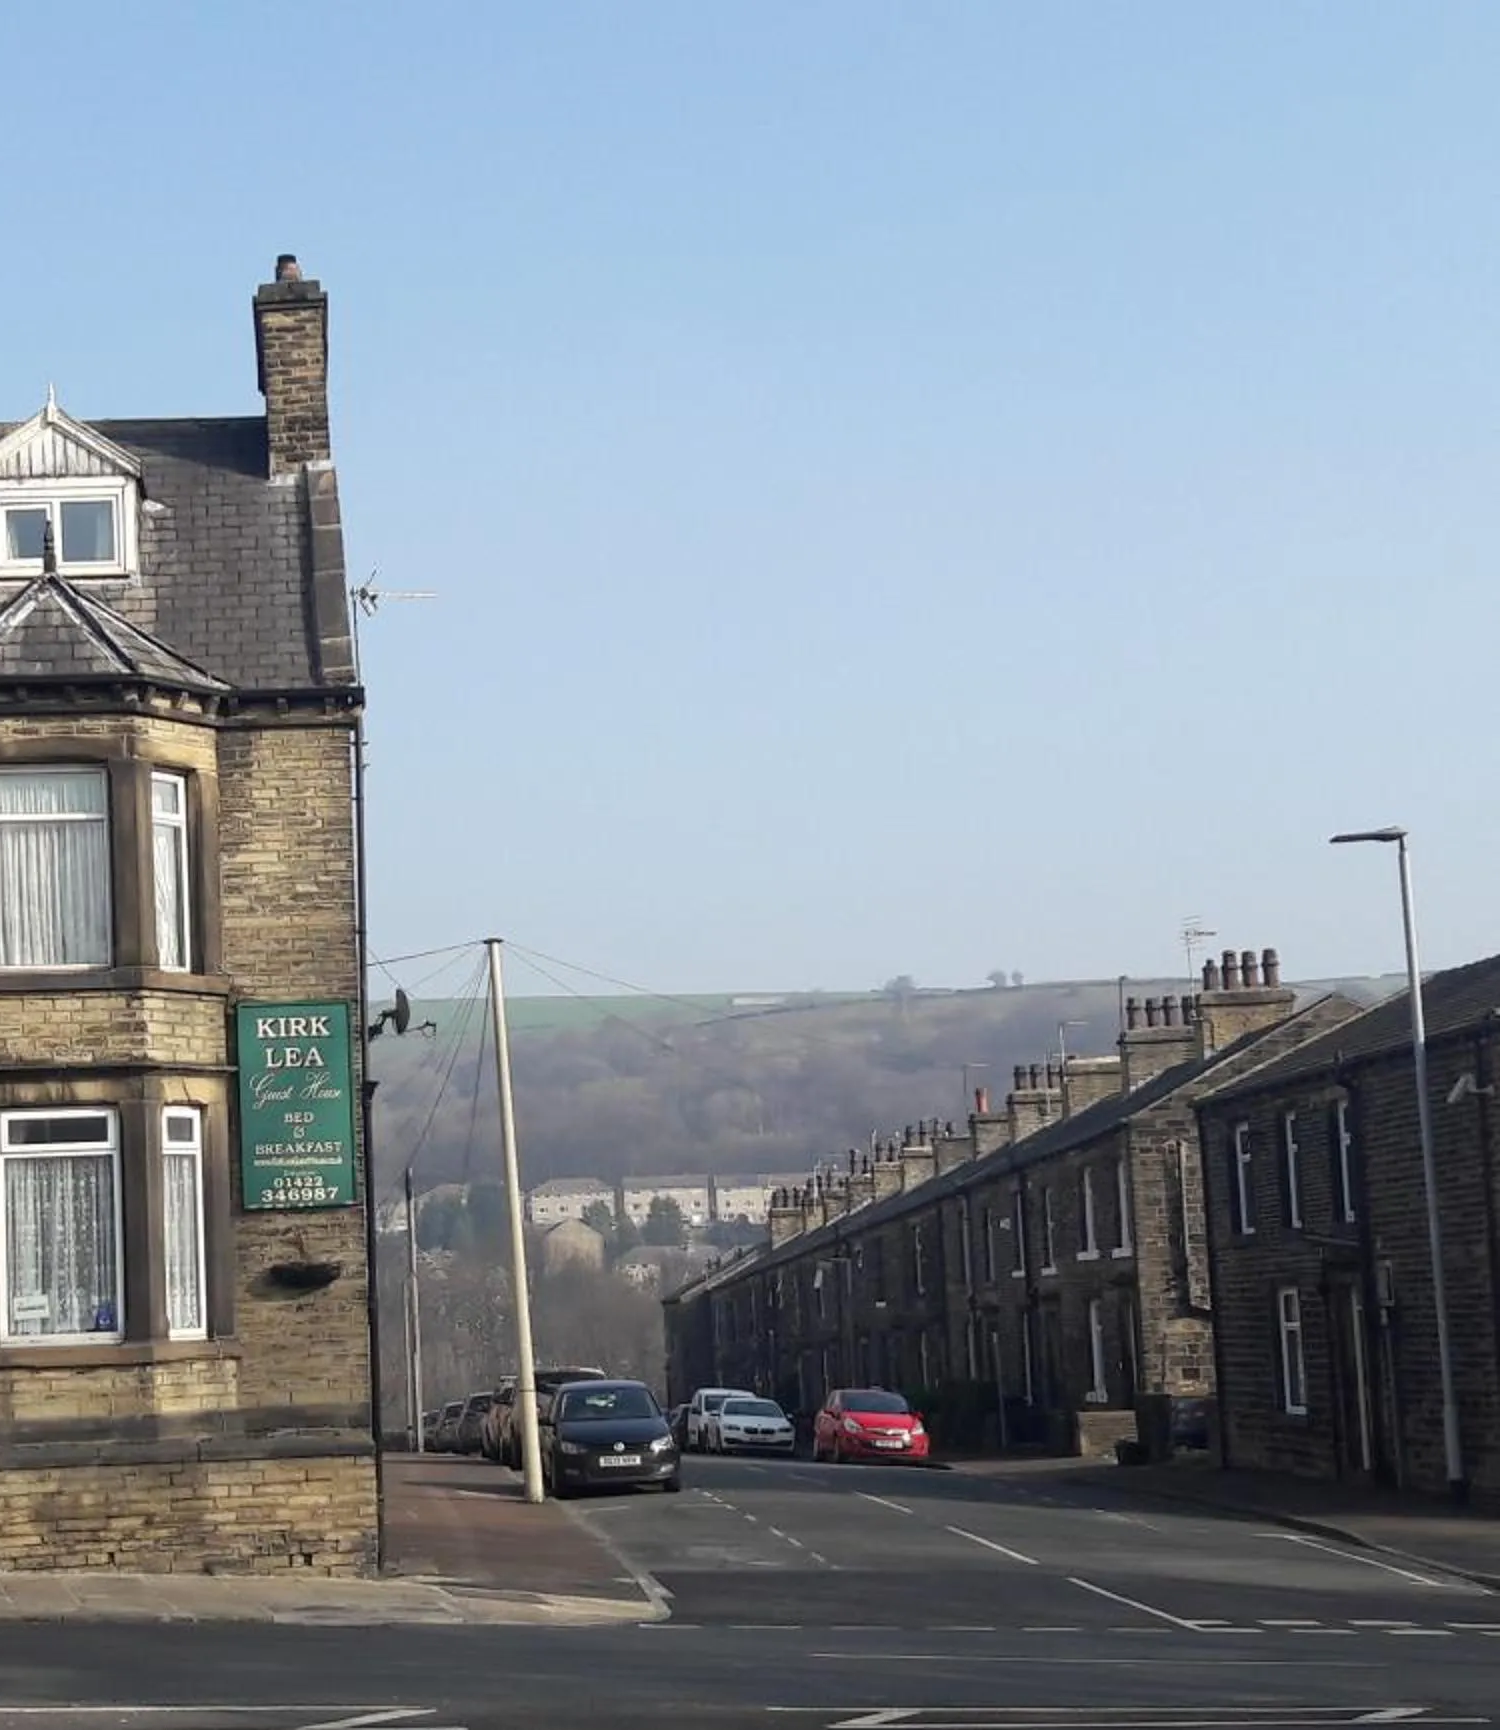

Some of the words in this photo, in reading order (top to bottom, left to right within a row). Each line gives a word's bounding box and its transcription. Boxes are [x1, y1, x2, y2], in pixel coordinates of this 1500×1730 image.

[256, 1015, 332, 1039] KIRK
[266, 1047, 325, 1068] LEA
[249, 1072, 293, 1110] Guest
[299, 1071, 342, 1101] House
[283, 1111, 315, 1124] BED
[293, 1125, 305, 1139] &
[255, 1141, 343, 1156] BREAKFAST
[273, 1175, 324, 1189] 01422
[261, 1186, 339, 1203] 346987
